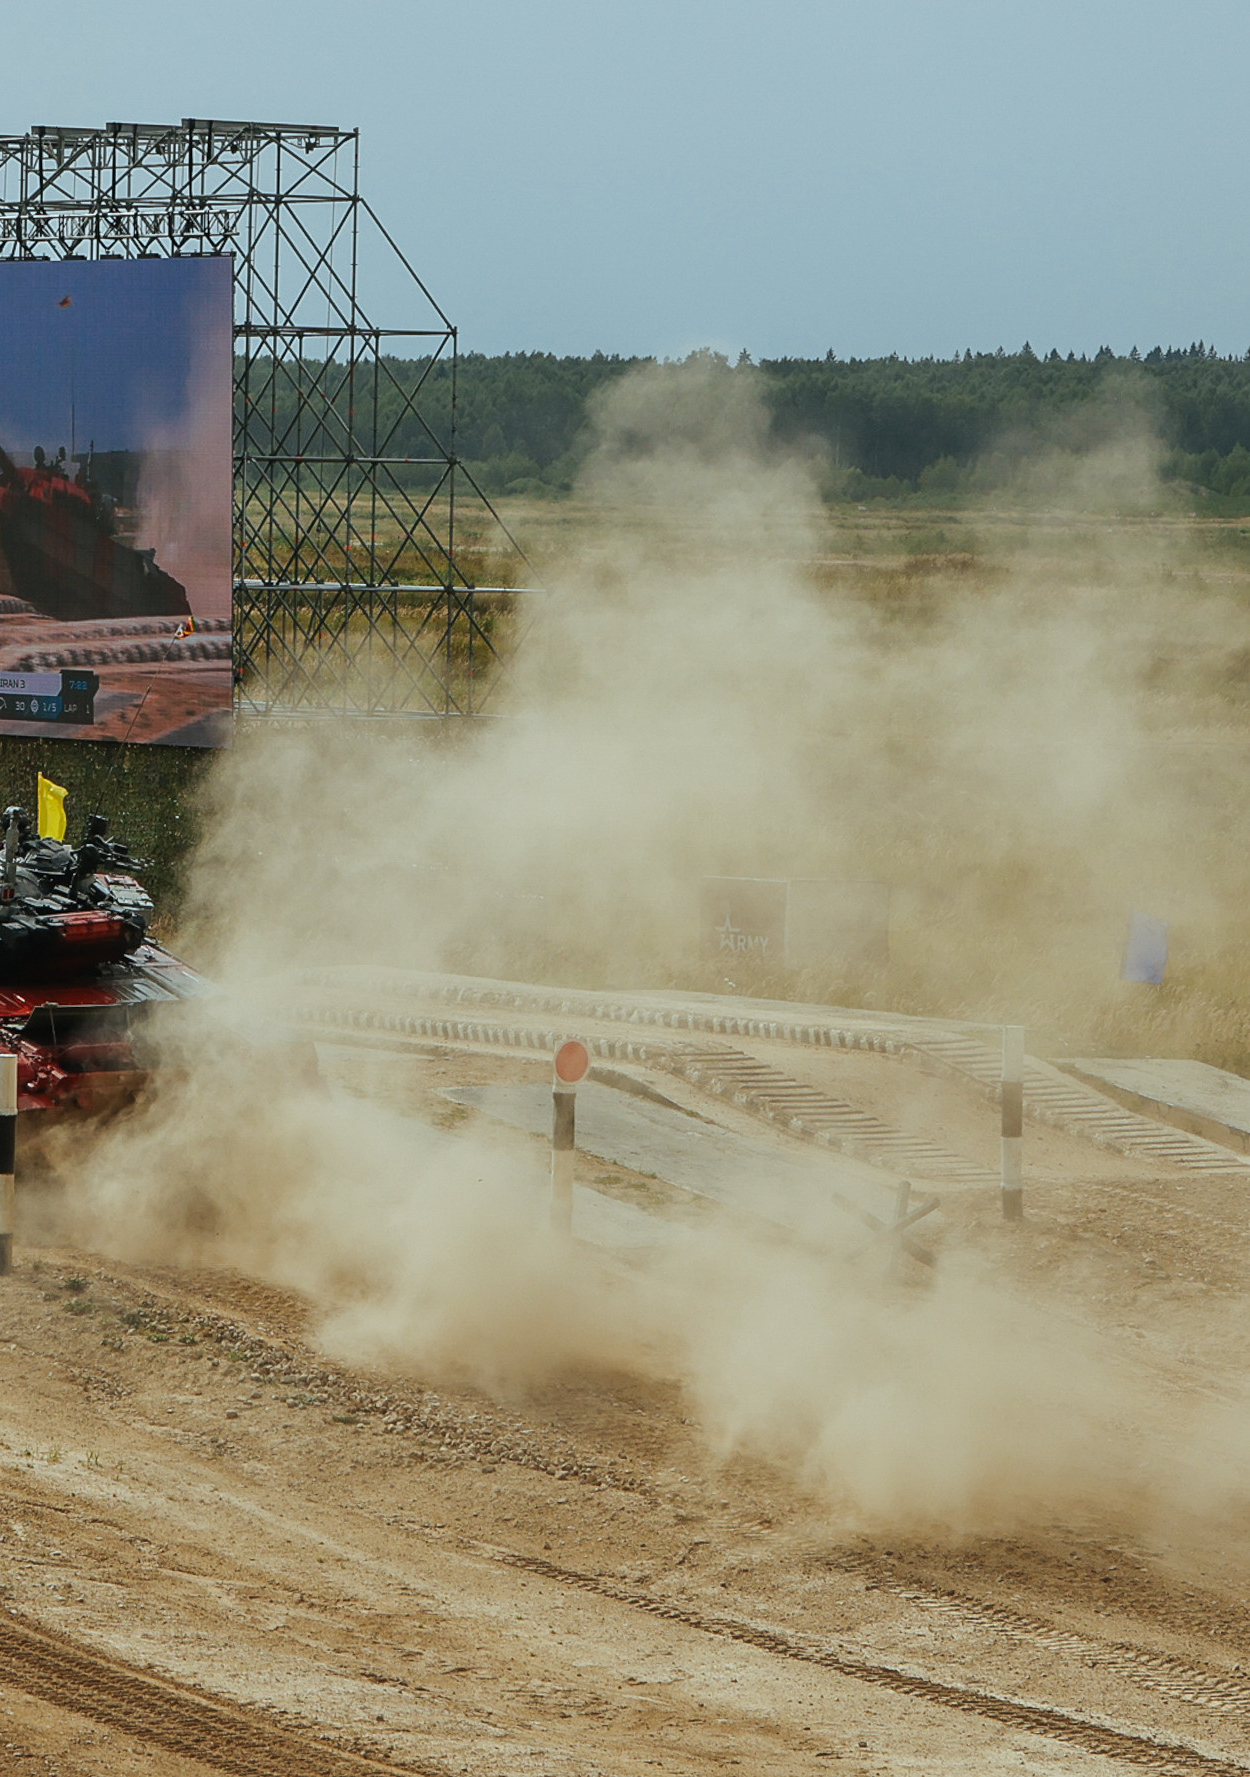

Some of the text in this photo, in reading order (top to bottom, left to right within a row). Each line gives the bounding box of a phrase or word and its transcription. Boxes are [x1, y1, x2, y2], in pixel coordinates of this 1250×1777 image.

[0, 680, 26, 689] IRAN 3
[15, 701, 25, 711] 30
[63, 704, 77, 713] LAP
